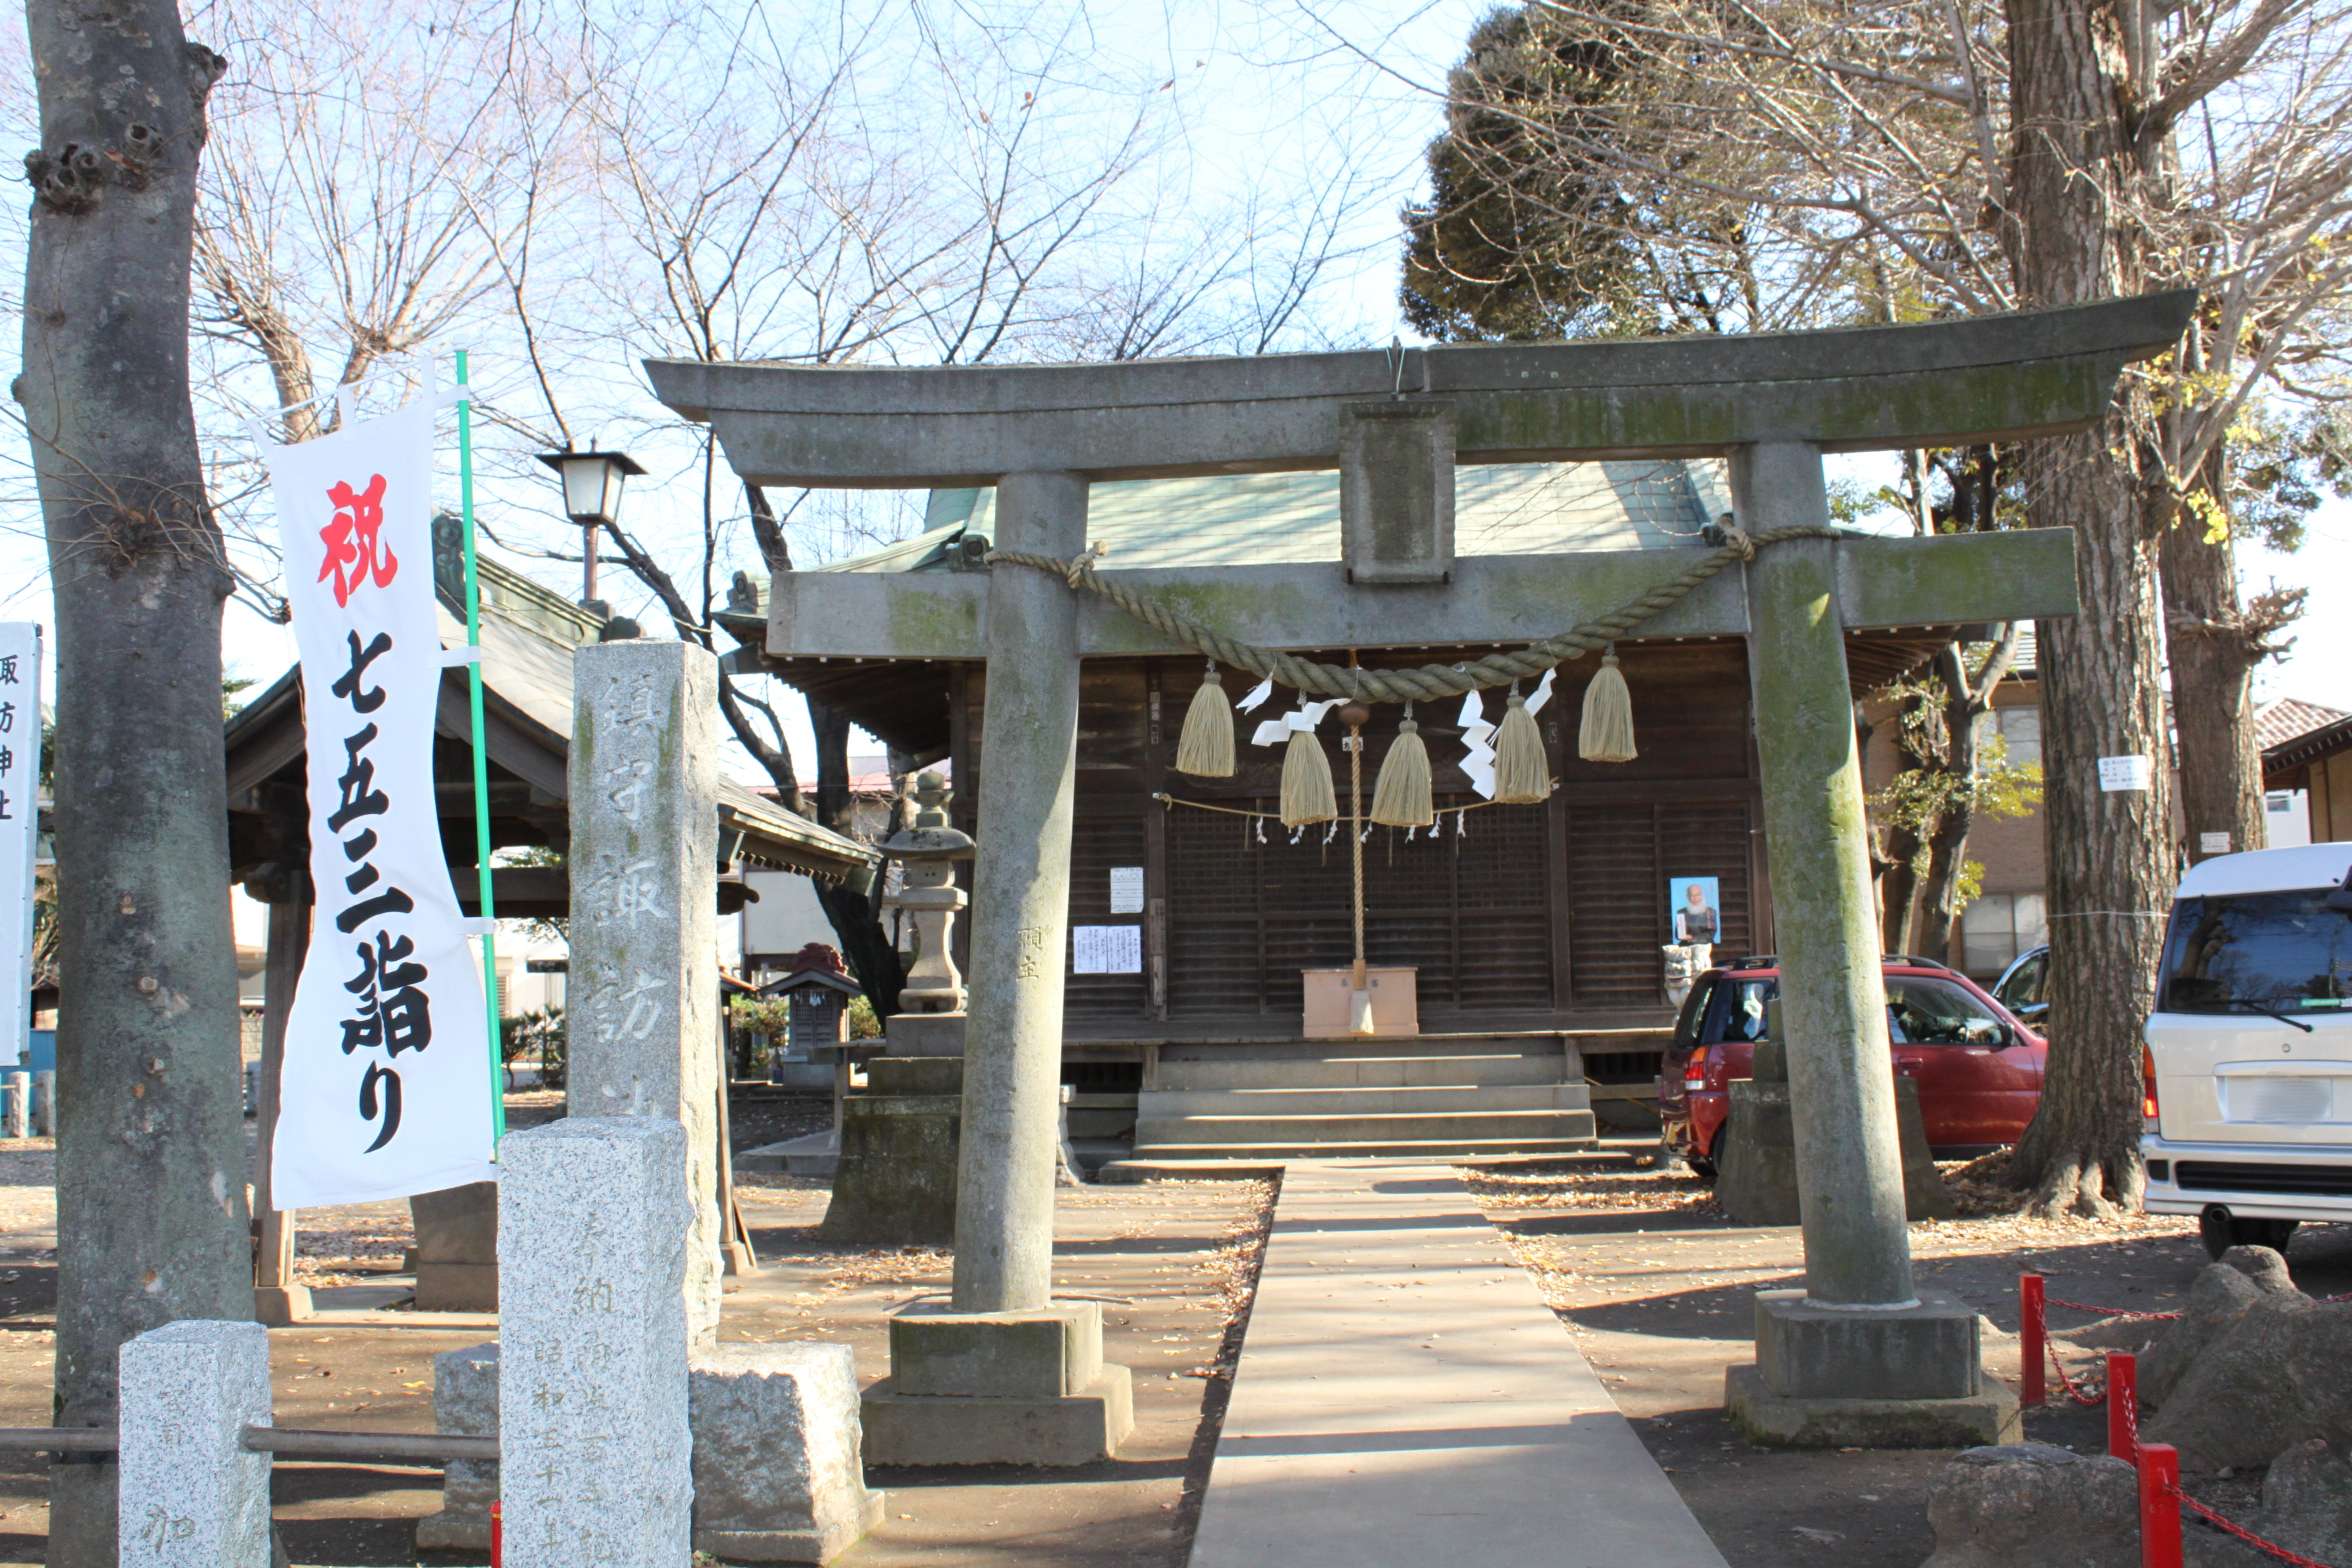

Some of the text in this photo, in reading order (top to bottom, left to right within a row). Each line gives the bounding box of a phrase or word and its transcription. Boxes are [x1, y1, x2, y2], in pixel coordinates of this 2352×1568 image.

[317, 473, 433, 1154] 祝 七五三詣り
